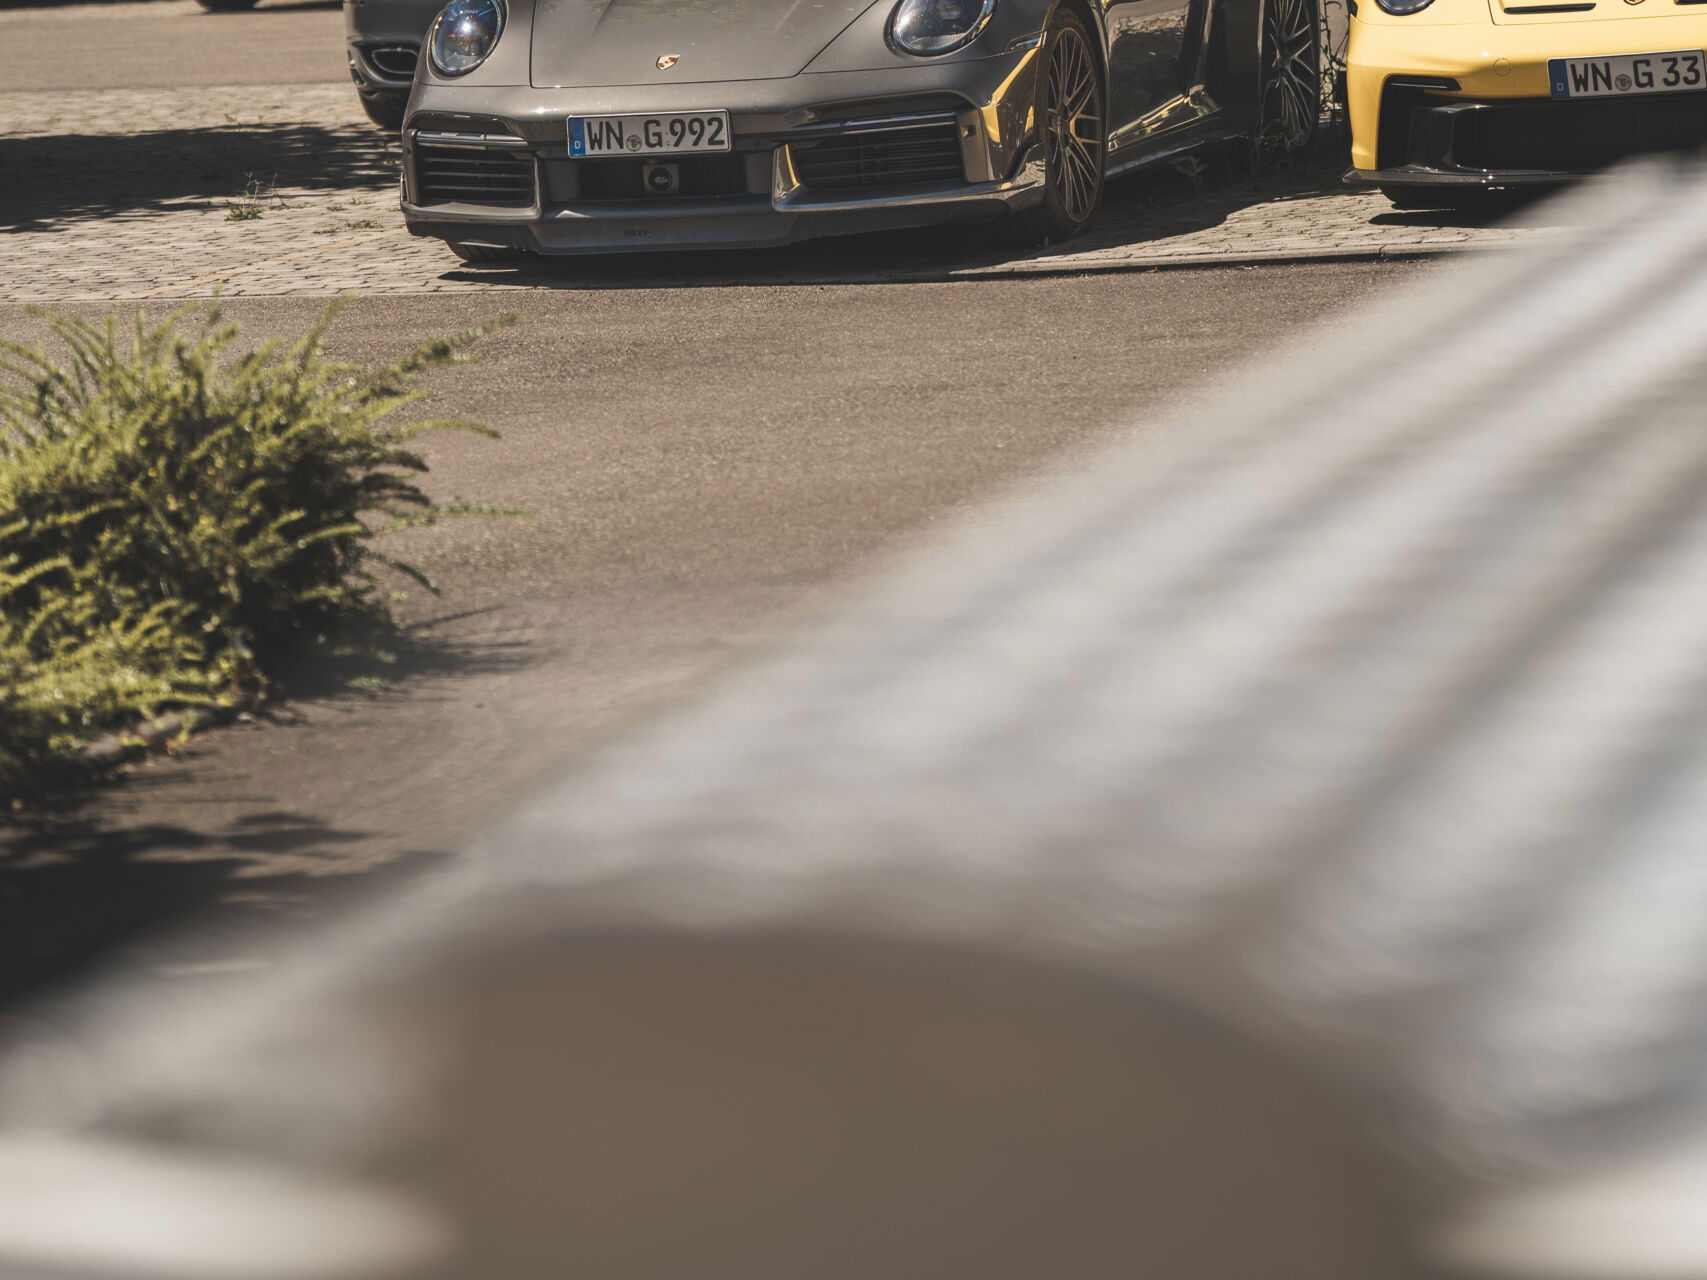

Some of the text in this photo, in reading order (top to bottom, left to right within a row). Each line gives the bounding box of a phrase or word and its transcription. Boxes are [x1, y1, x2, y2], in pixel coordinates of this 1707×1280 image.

[1557, 55, 1700, 92] D WN G 33
[574, 117, 725, 150] D WN G 992
